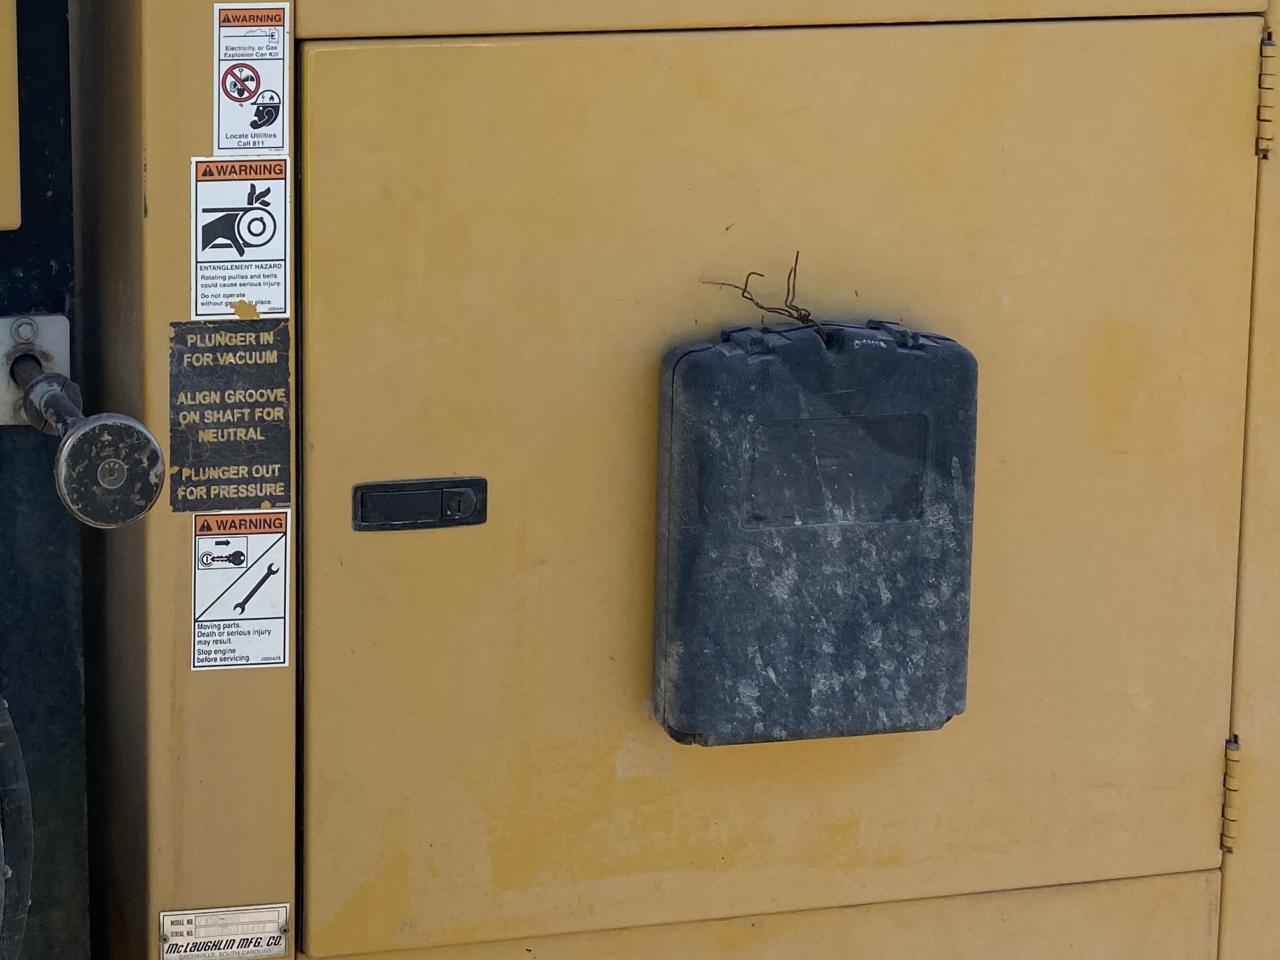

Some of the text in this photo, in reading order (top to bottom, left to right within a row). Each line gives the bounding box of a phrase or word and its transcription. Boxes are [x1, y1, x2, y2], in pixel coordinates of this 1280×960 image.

[231, 14, 282, 23] WARNING
[215, 163, 284, 176] WARNING
[199, 263, 253, 271] ENTANGLEMENT
[187, 331, 274, 347] PLUNGER IN
[183, 350, 278, 367] FOR VACUUM
[176, 388, 285, 405] ALIGN GROOVE
[178, 407, 285, 424] ON SHAFT FOR
[198, 426, 265, 442] NEUTRAL
[181, 464, 281, 481] PLUNGER OUT
[177, 482, 285, 500] FOR PRESSURE
[215, 517, 283, 531] WARNING
[197, 630, 217, 638] Death
[252, 628, 271, 637] injury
[197, 647, 236, 656] Stop engine
[197, 656, 218, 664] before
[236, 936, 263, 949] MFG.
